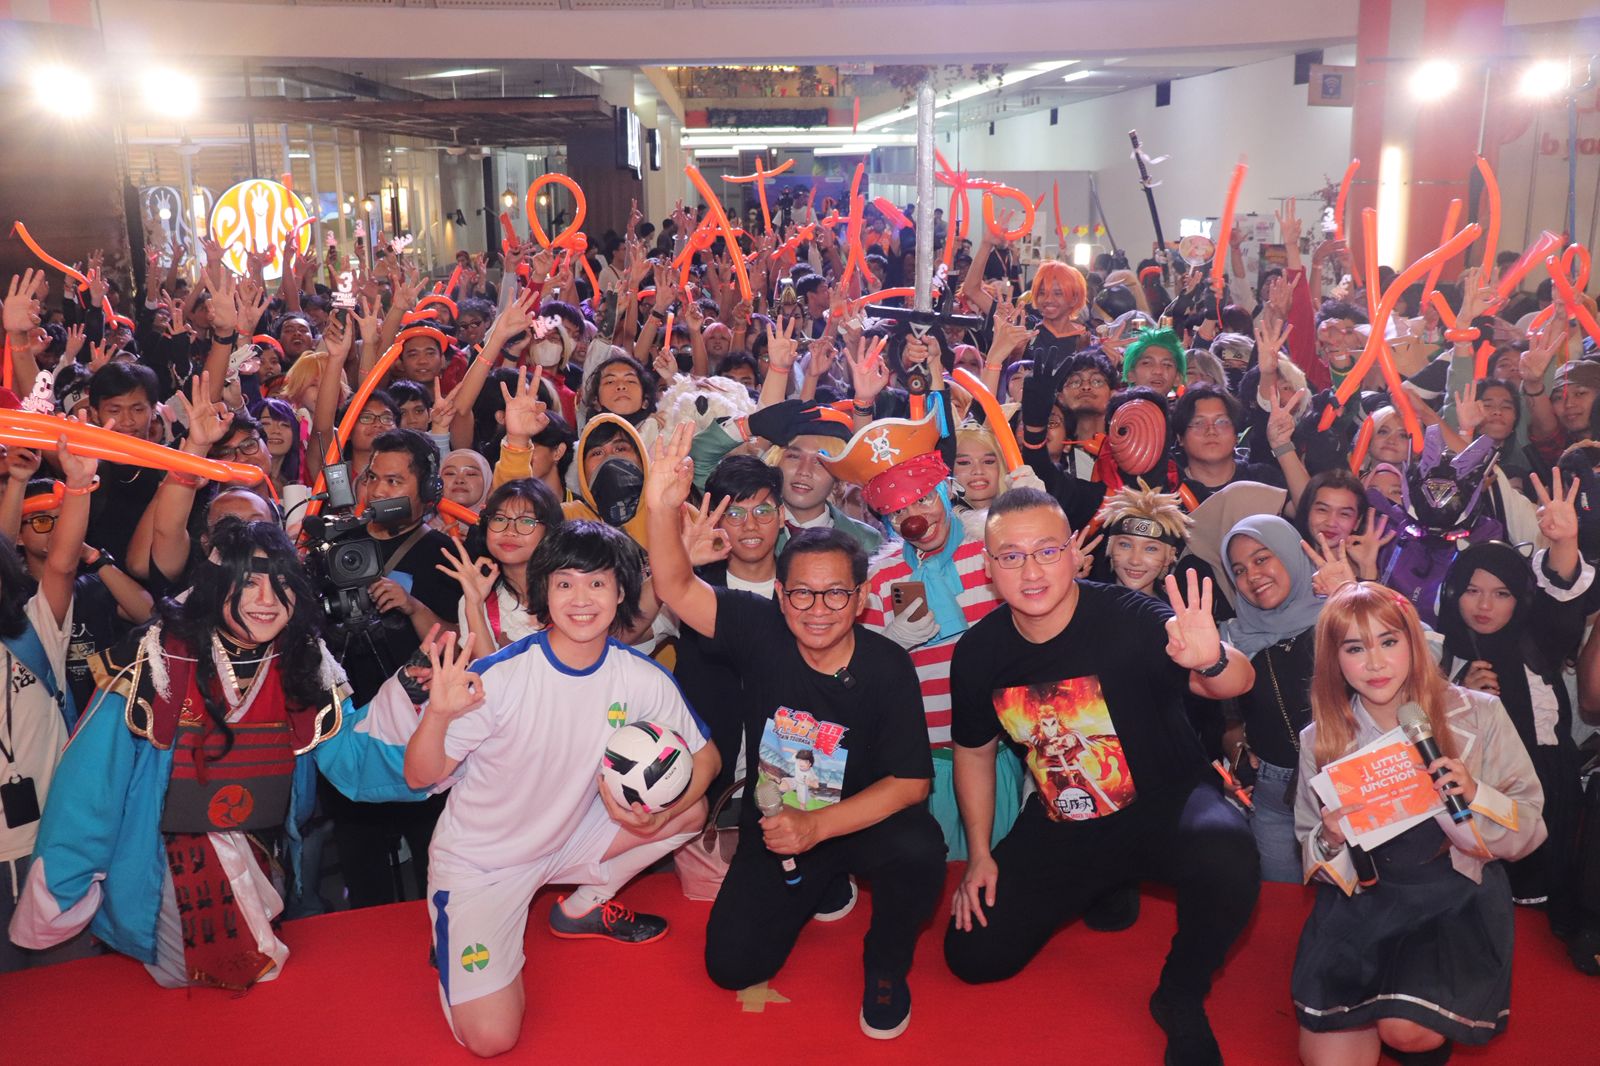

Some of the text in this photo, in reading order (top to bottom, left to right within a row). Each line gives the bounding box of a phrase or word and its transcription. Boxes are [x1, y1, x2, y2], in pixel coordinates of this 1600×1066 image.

[337, 271, 354, 293] 3
[1371, 751, 1408, 770] LITTLE
[1375, 761, 1412, 778] TOKYO
[1360, 769, 1416, 795] JUNCTION
